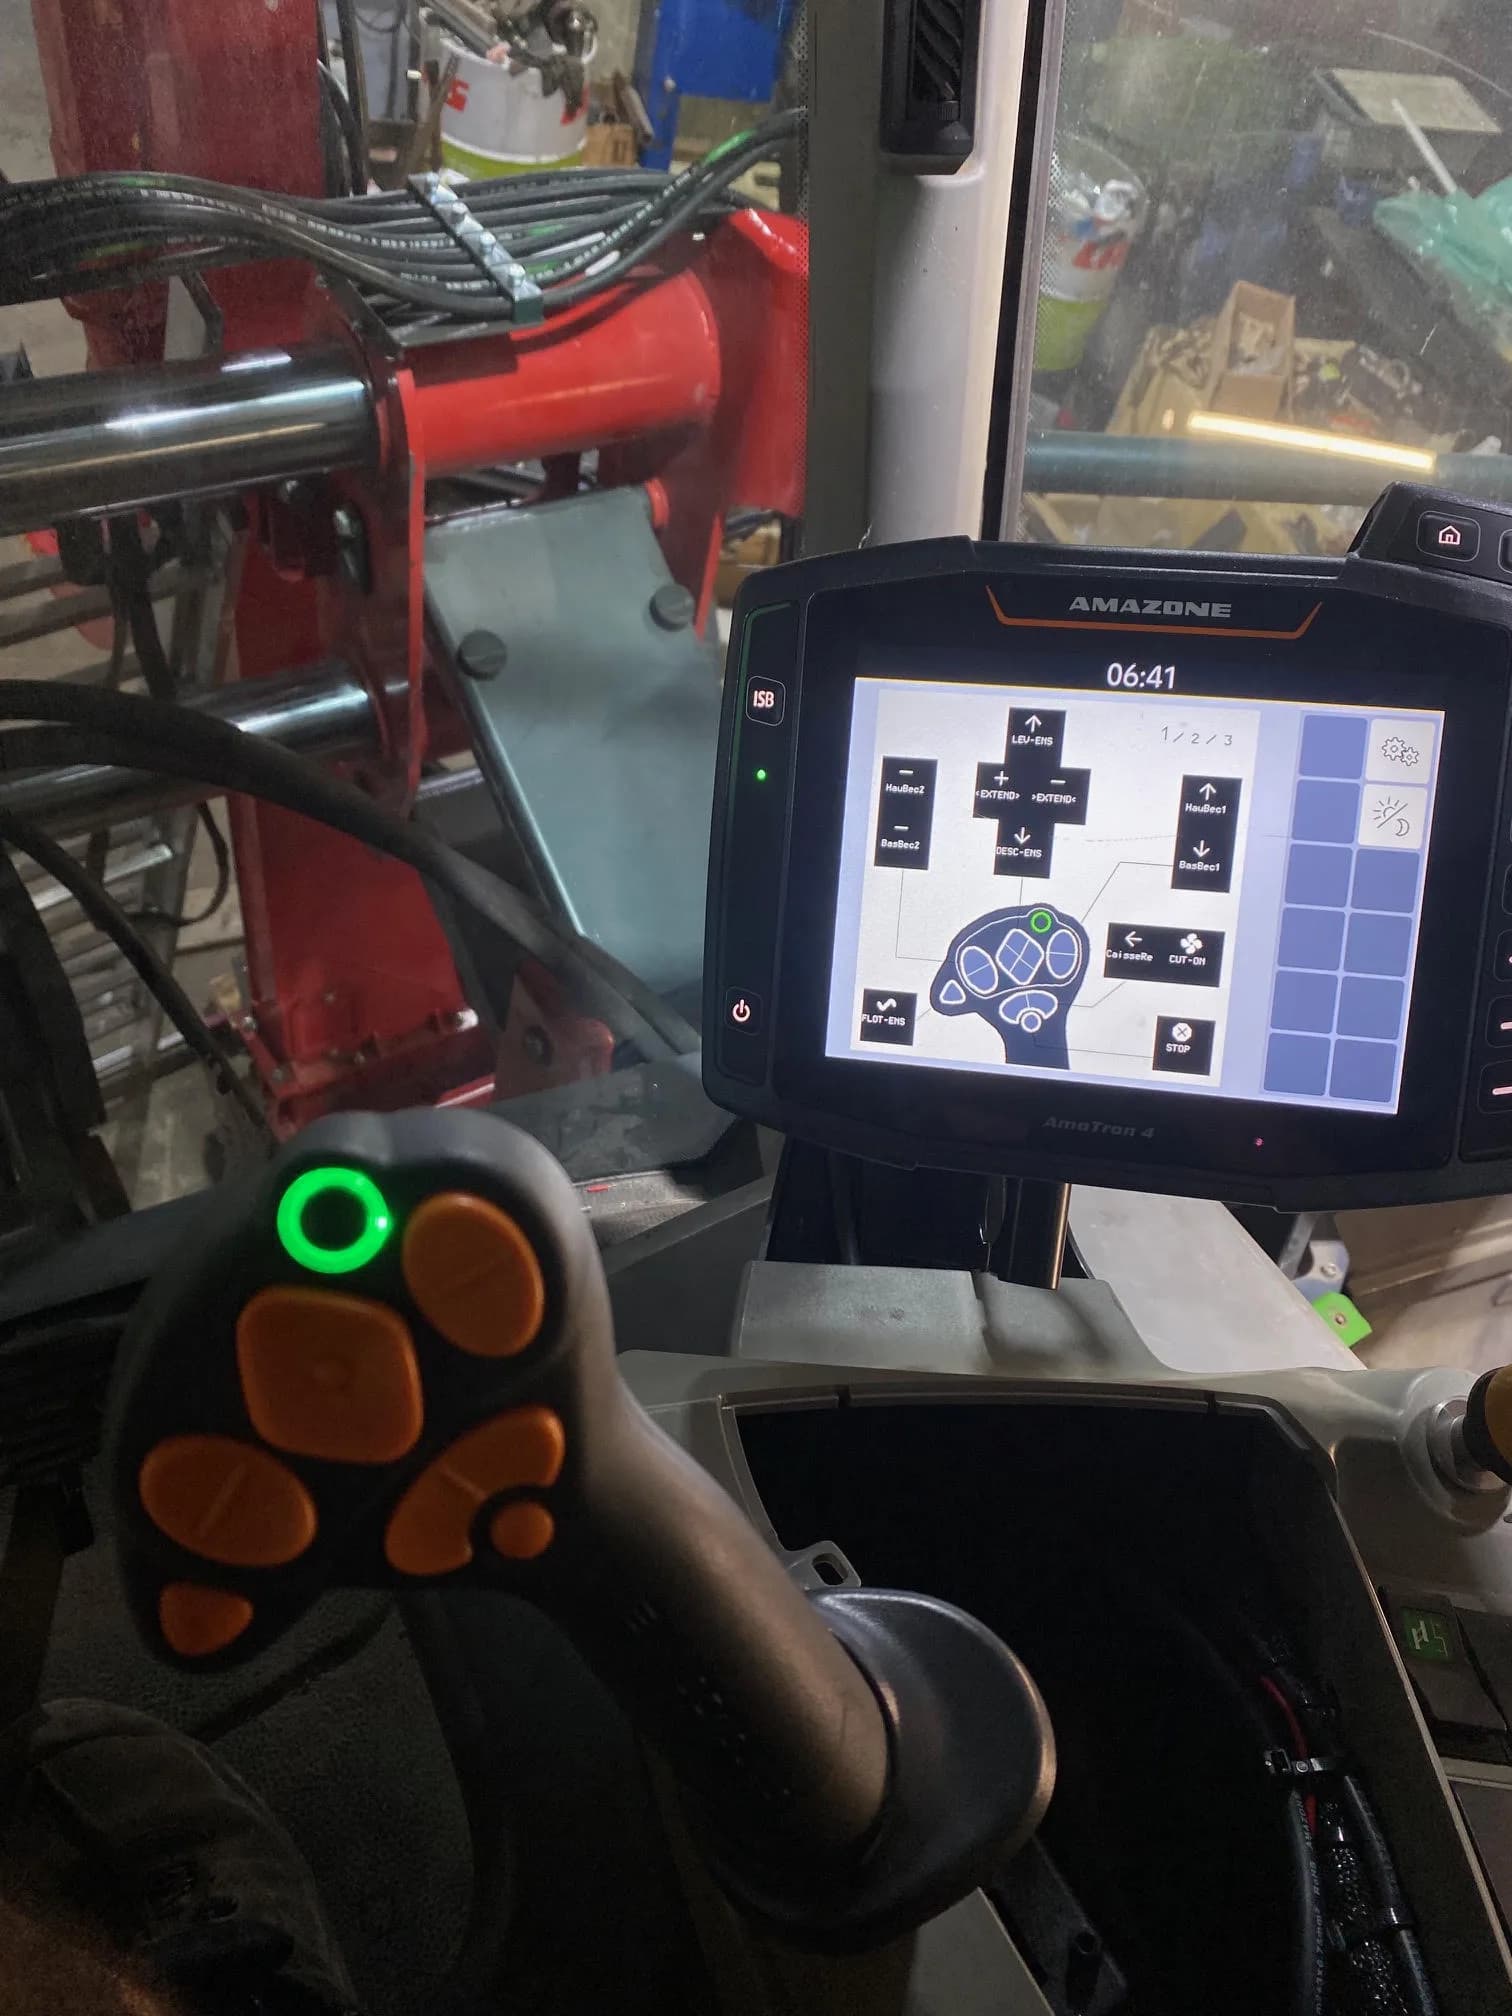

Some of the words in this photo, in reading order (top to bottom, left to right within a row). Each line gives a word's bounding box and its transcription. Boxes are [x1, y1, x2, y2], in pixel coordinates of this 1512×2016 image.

[1068, 596, 1232, 618] AMAZONE
[1106, 662, 1176, 690] 06:41
[753, 690, 775, 708] ISB
[1011, 734, 1054, 746] LEV-ENS
[885, 783, 926, 795] HauBec2
[1184, 802, 1227, 815] HauBec1
[880, 838, 921, 850] BasBec2
[995, 846, 1042, 858] DESC-ENS
[1178, 860, 1221, 872] BasBec1
[1105, 949, 1154, 962] CaisseRe
[1168, 954, 1207, 966] CUT-ON
[861, 1013, 906, 1026] FLOT-ENS
[1165, 1043, 1191, 1054] STOP
[1140, 1127, 1154, 1139] 4
